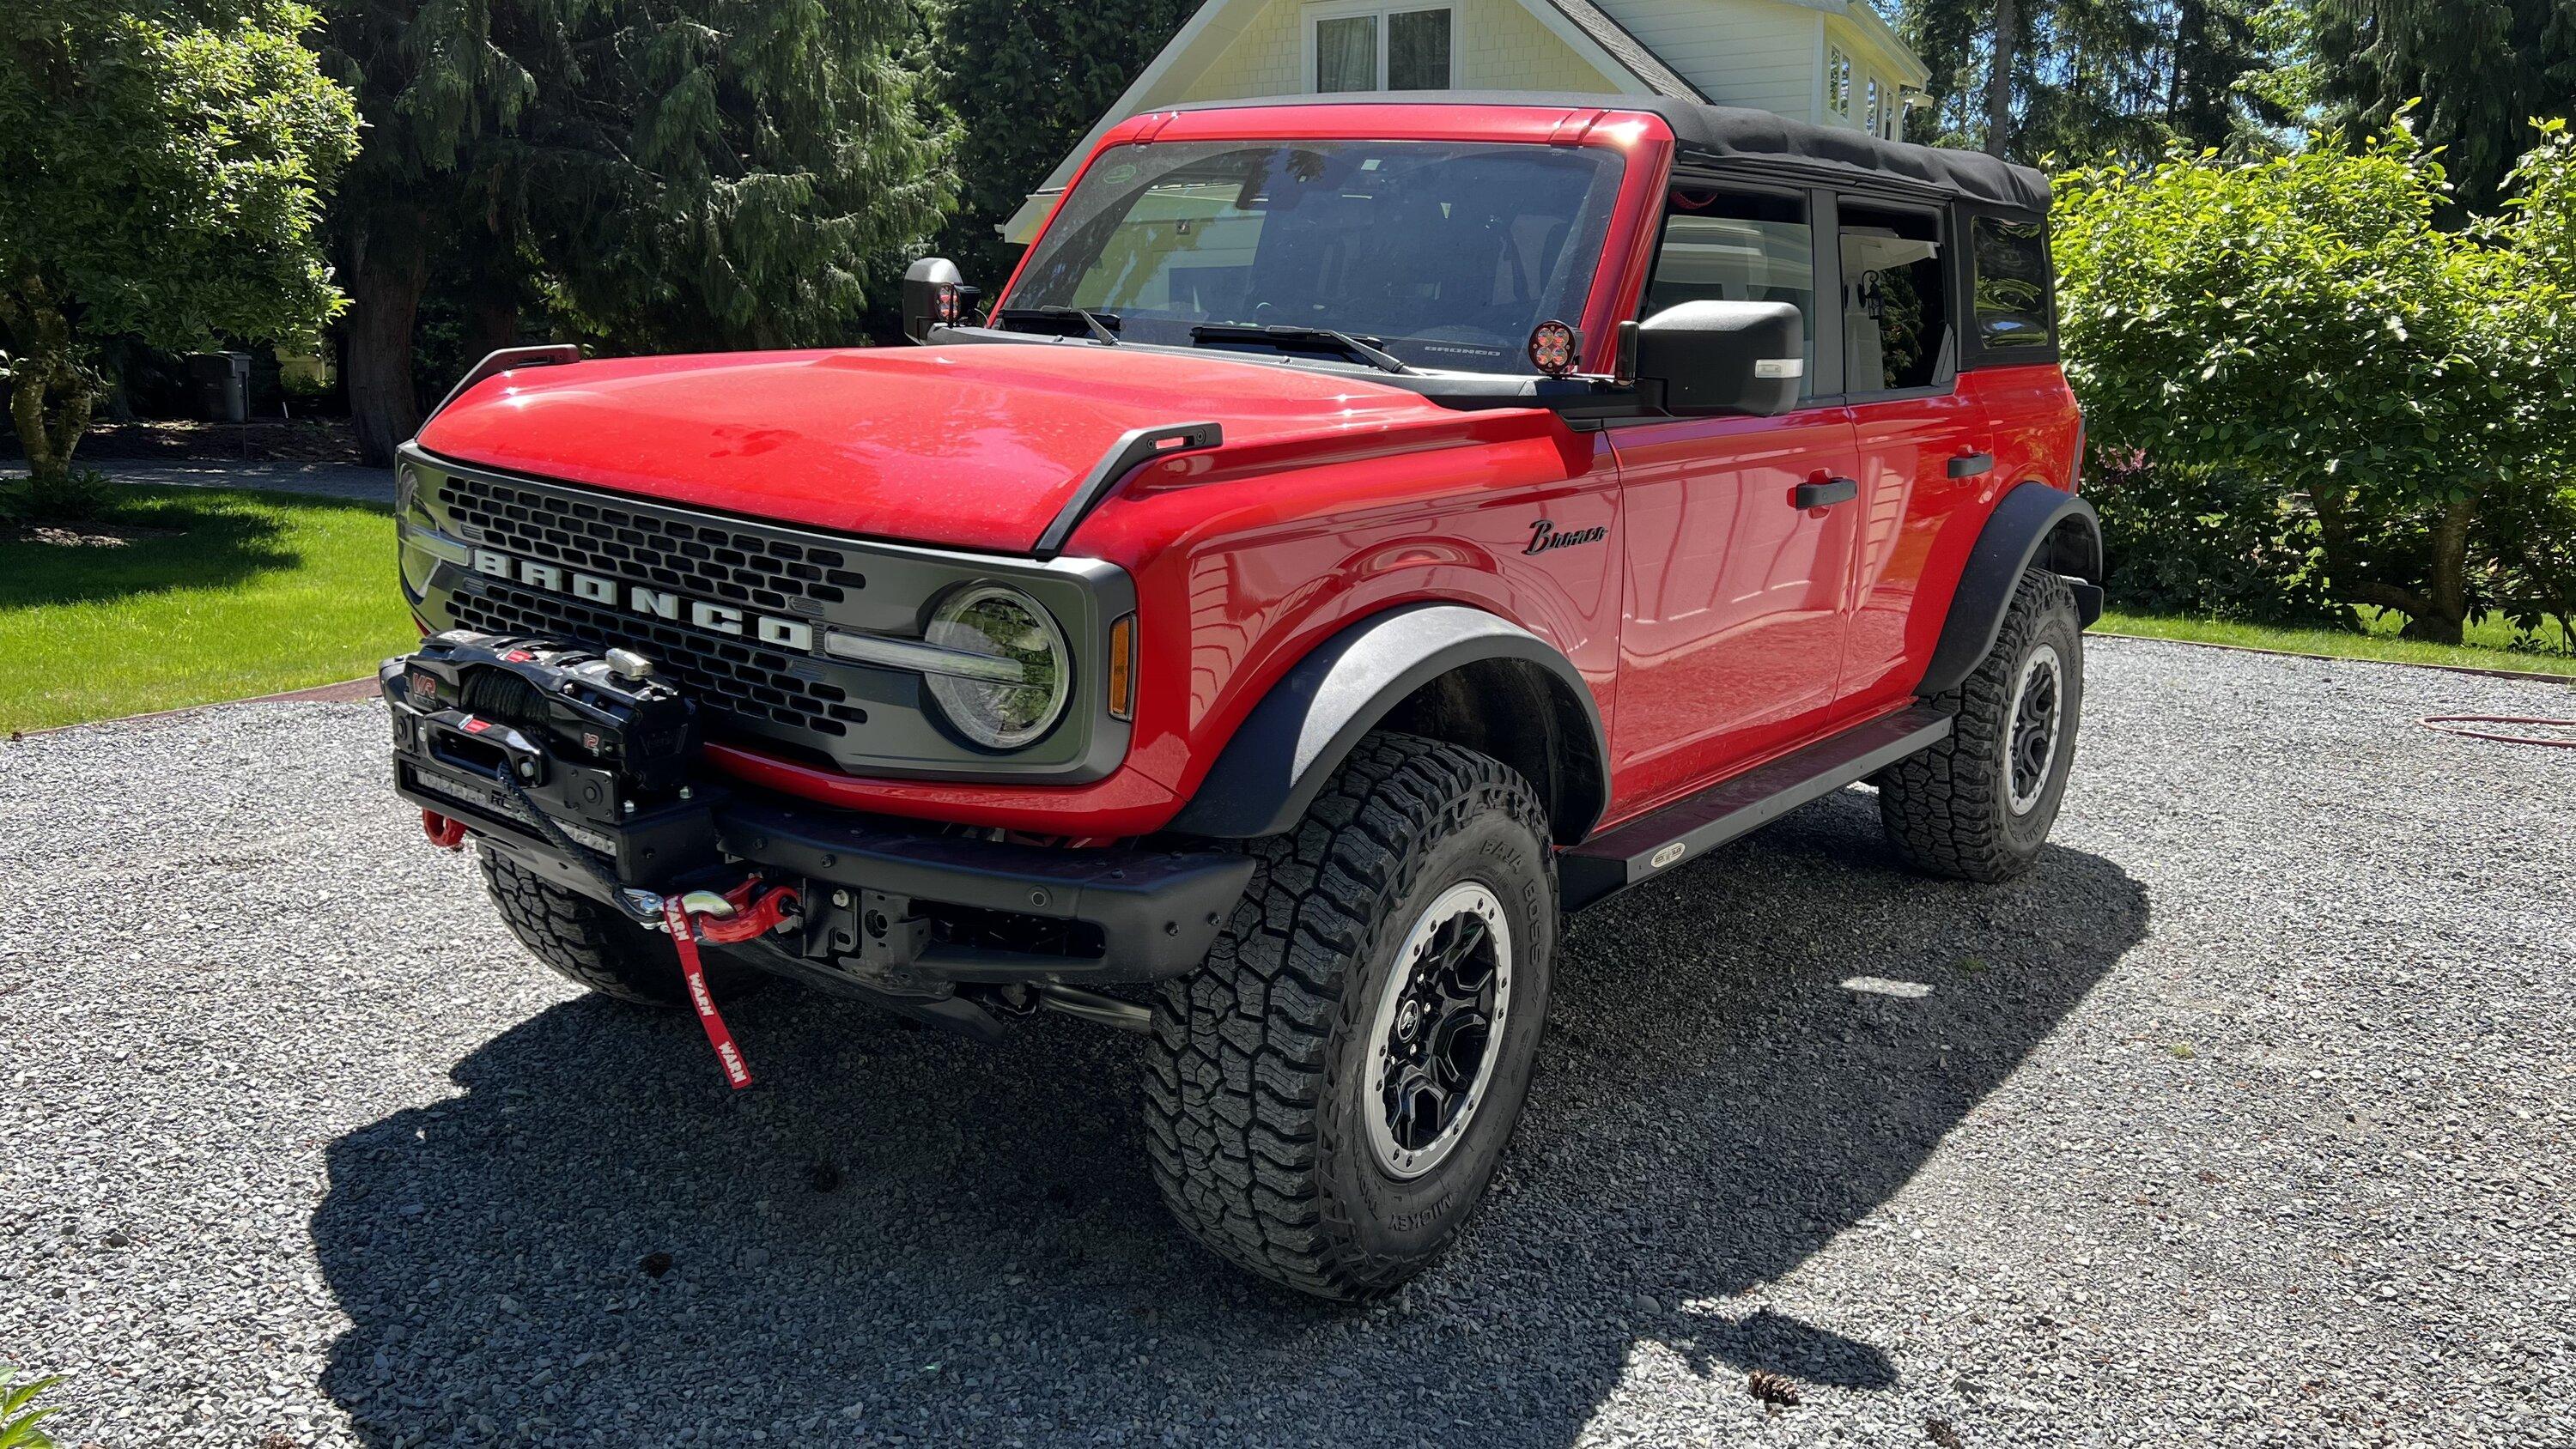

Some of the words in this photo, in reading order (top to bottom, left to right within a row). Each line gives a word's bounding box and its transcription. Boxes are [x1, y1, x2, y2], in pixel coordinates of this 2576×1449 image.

[1425, 346, 1501, 356] BRONCO
[1521, 519, 1609, 555] Bronco
[474, 549, 812, 652] BRONCO
[665, 895, 690, 942] WARN
[1479, 839, 1525, 876] BAJA
[1522, 878, 1542, 966] BOSS
[688, 972, 714, 1016] WARN
[718, 1040, 747, 1083] WARN
[1388, 1191, 1453, 1232] MICKEY
